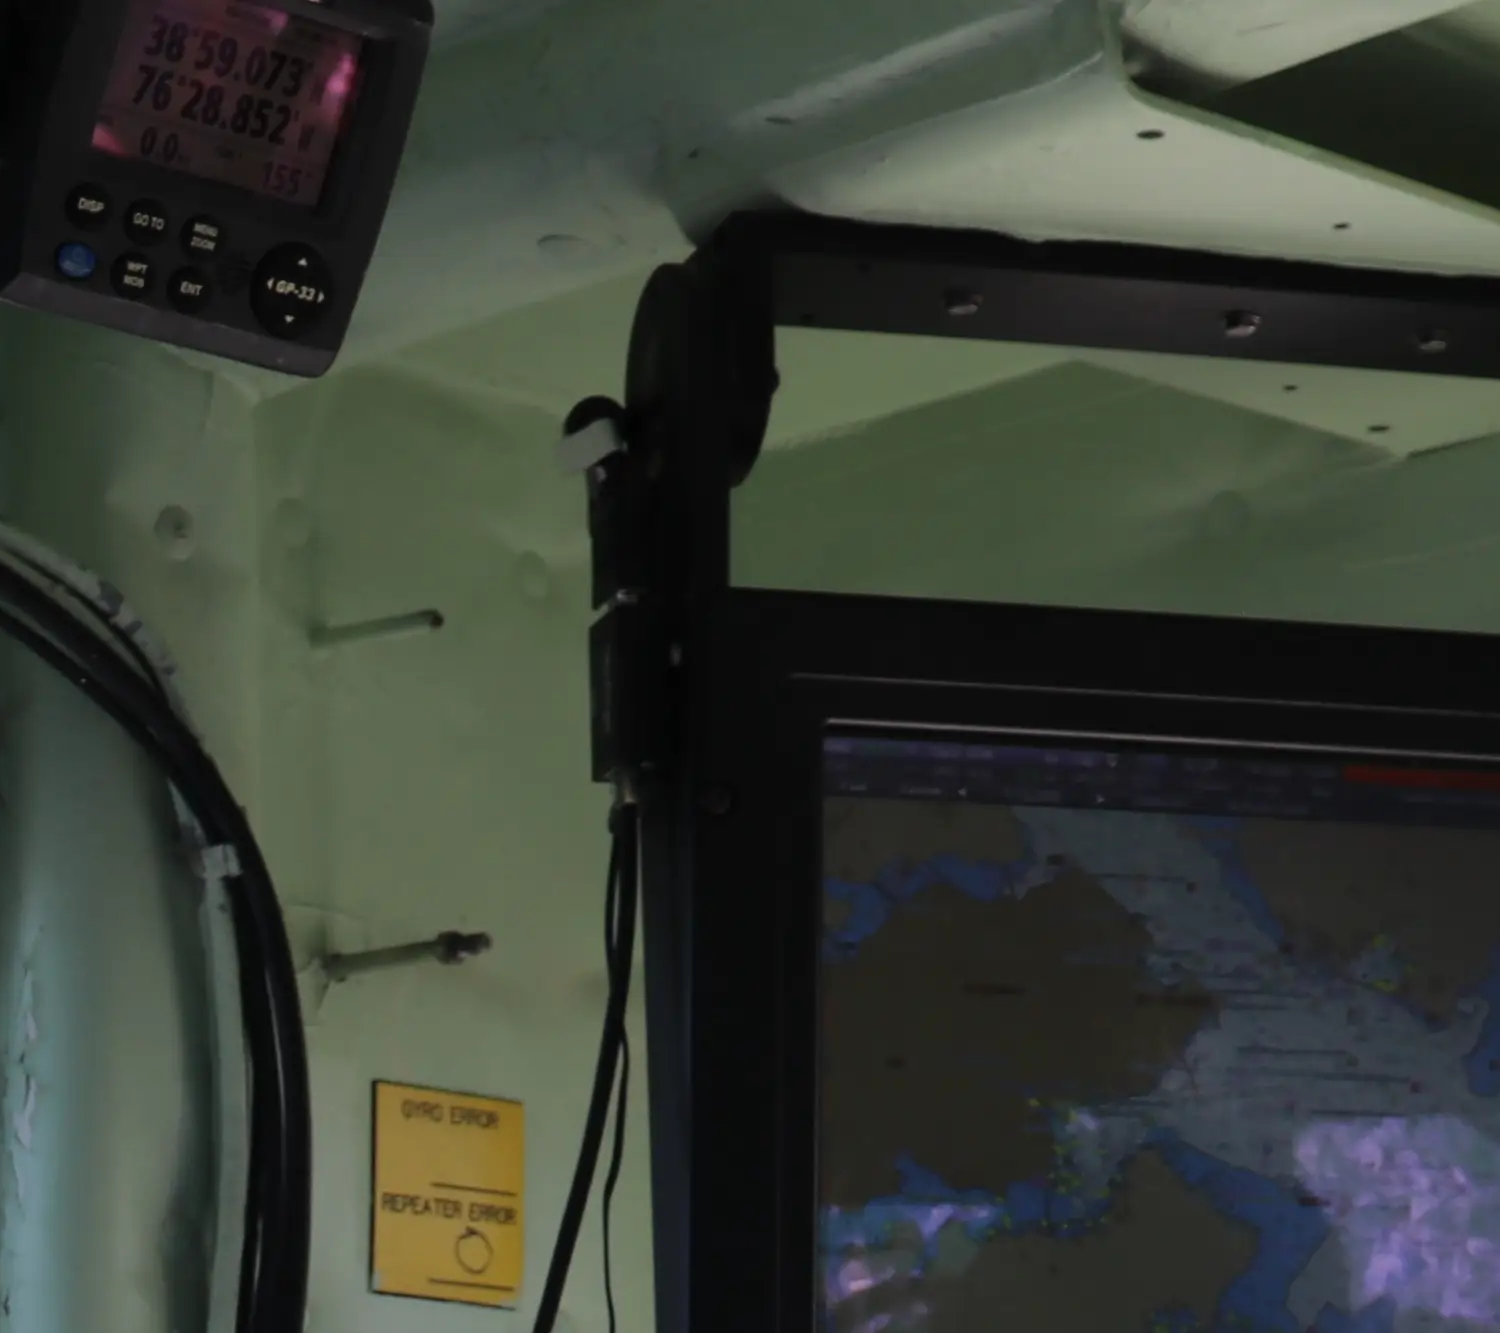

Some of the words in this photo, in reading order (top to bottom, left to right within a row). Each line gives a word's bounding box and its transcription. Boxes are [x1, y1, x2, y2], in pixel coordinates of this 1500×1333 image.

[77, 194, 105, 215] DISP
[132, 209, 150, 227] GO
[149, 214, 165, 232] TO
[180, 280, 204, 298] ENT
[275, 280, 316, 303] GP-33
[401, 1099, 444, 1123] GYRO
[449, 1105, 500, 1130] ERROR
[382, 1192, 464, 1222] REPEATER
[467, 1202, 518, 1225] ERROR
